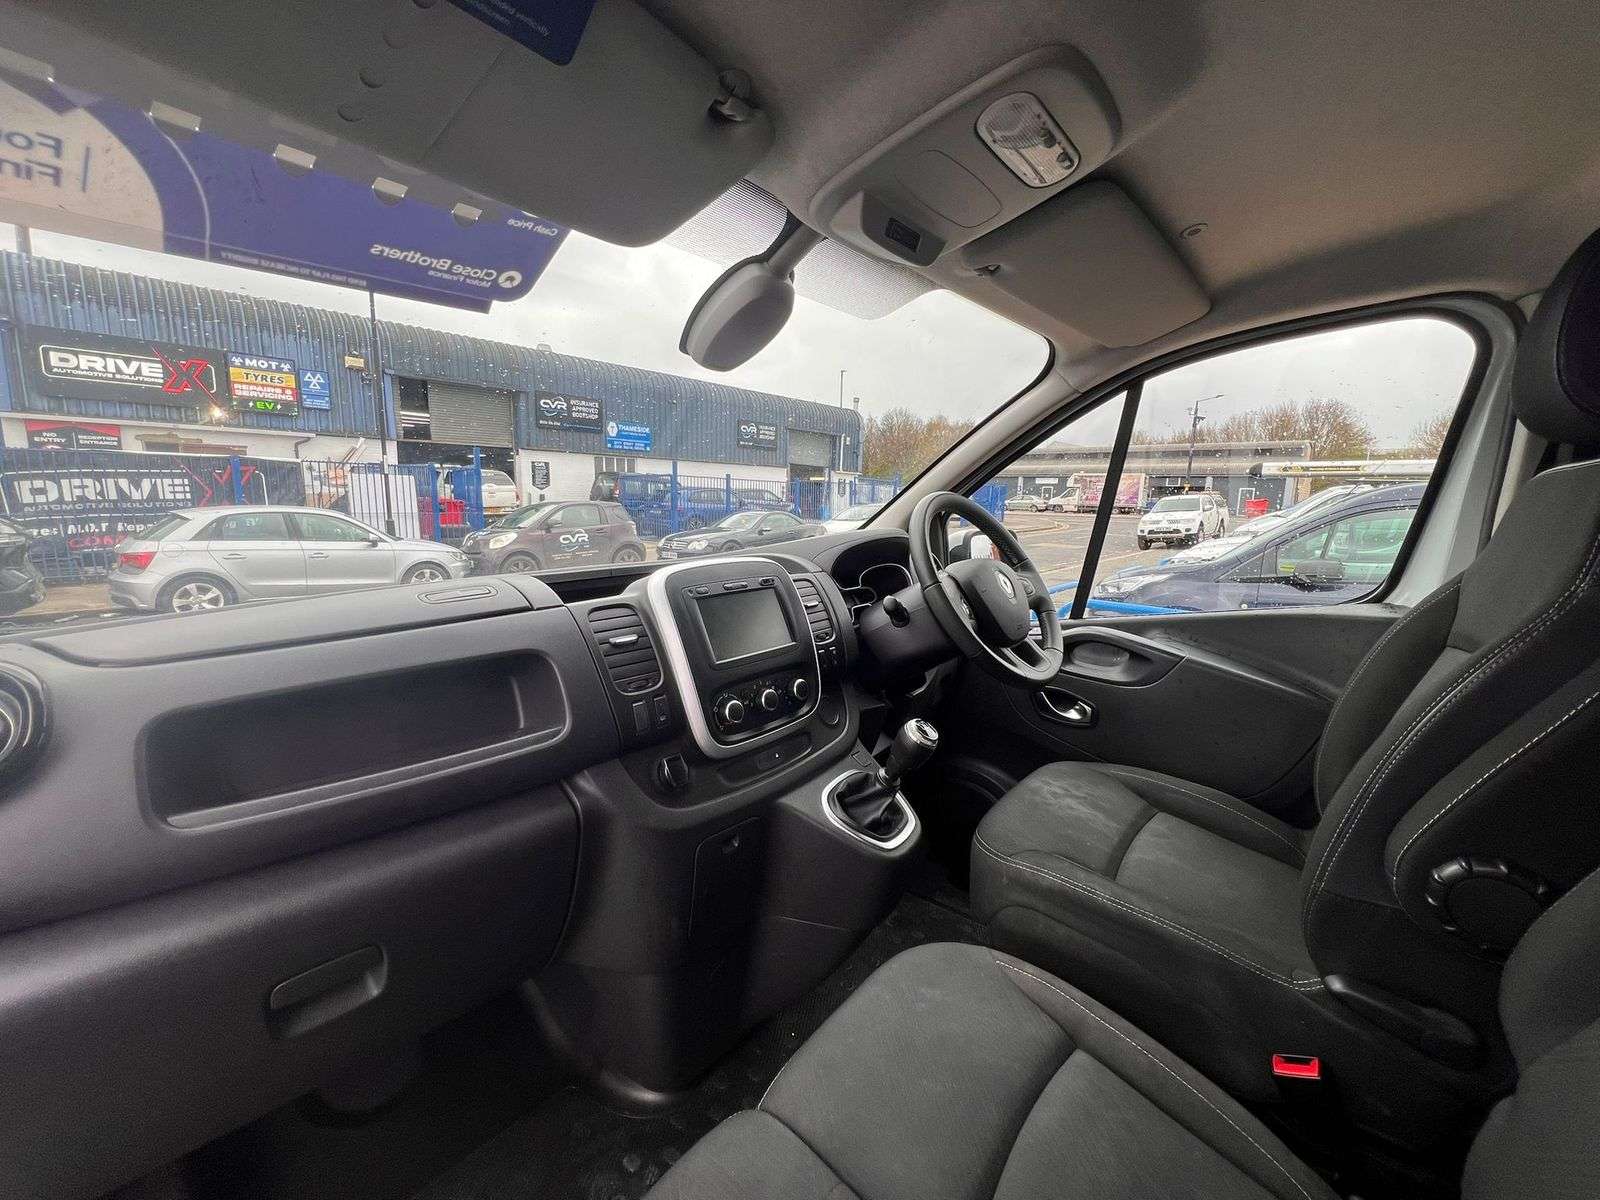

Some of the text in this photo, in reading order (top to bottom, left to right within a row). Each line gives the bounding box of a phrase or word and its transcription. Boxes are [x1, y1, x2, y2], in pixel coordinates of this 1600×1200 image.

[49, 351, 164, 378] DRIVE
[245, 359, 279, 369] MOT
[52, 367, 164, 384] AUTOMOTIVE SOLUTIONS
[243, 372, 285, 385] TYRES
[233, 383, 282, 393] REPAIRS
[234, 389, 294, 401] SERVICING
[256, 401, 275, 410] EV
[540, 399, 567, 410] CVR
[570, 400, 600, 408] INSURANCE
[571, 406, 599, 414] APPROVED
[571, 412, 599, 420] BODYSHOP
[618, 424, 650, 433] THAMESIDE
[741, 425, 757, 434] CVR
[14, 477, 191, 503] DRIVE
[560, 533, 589, 543] CVR
